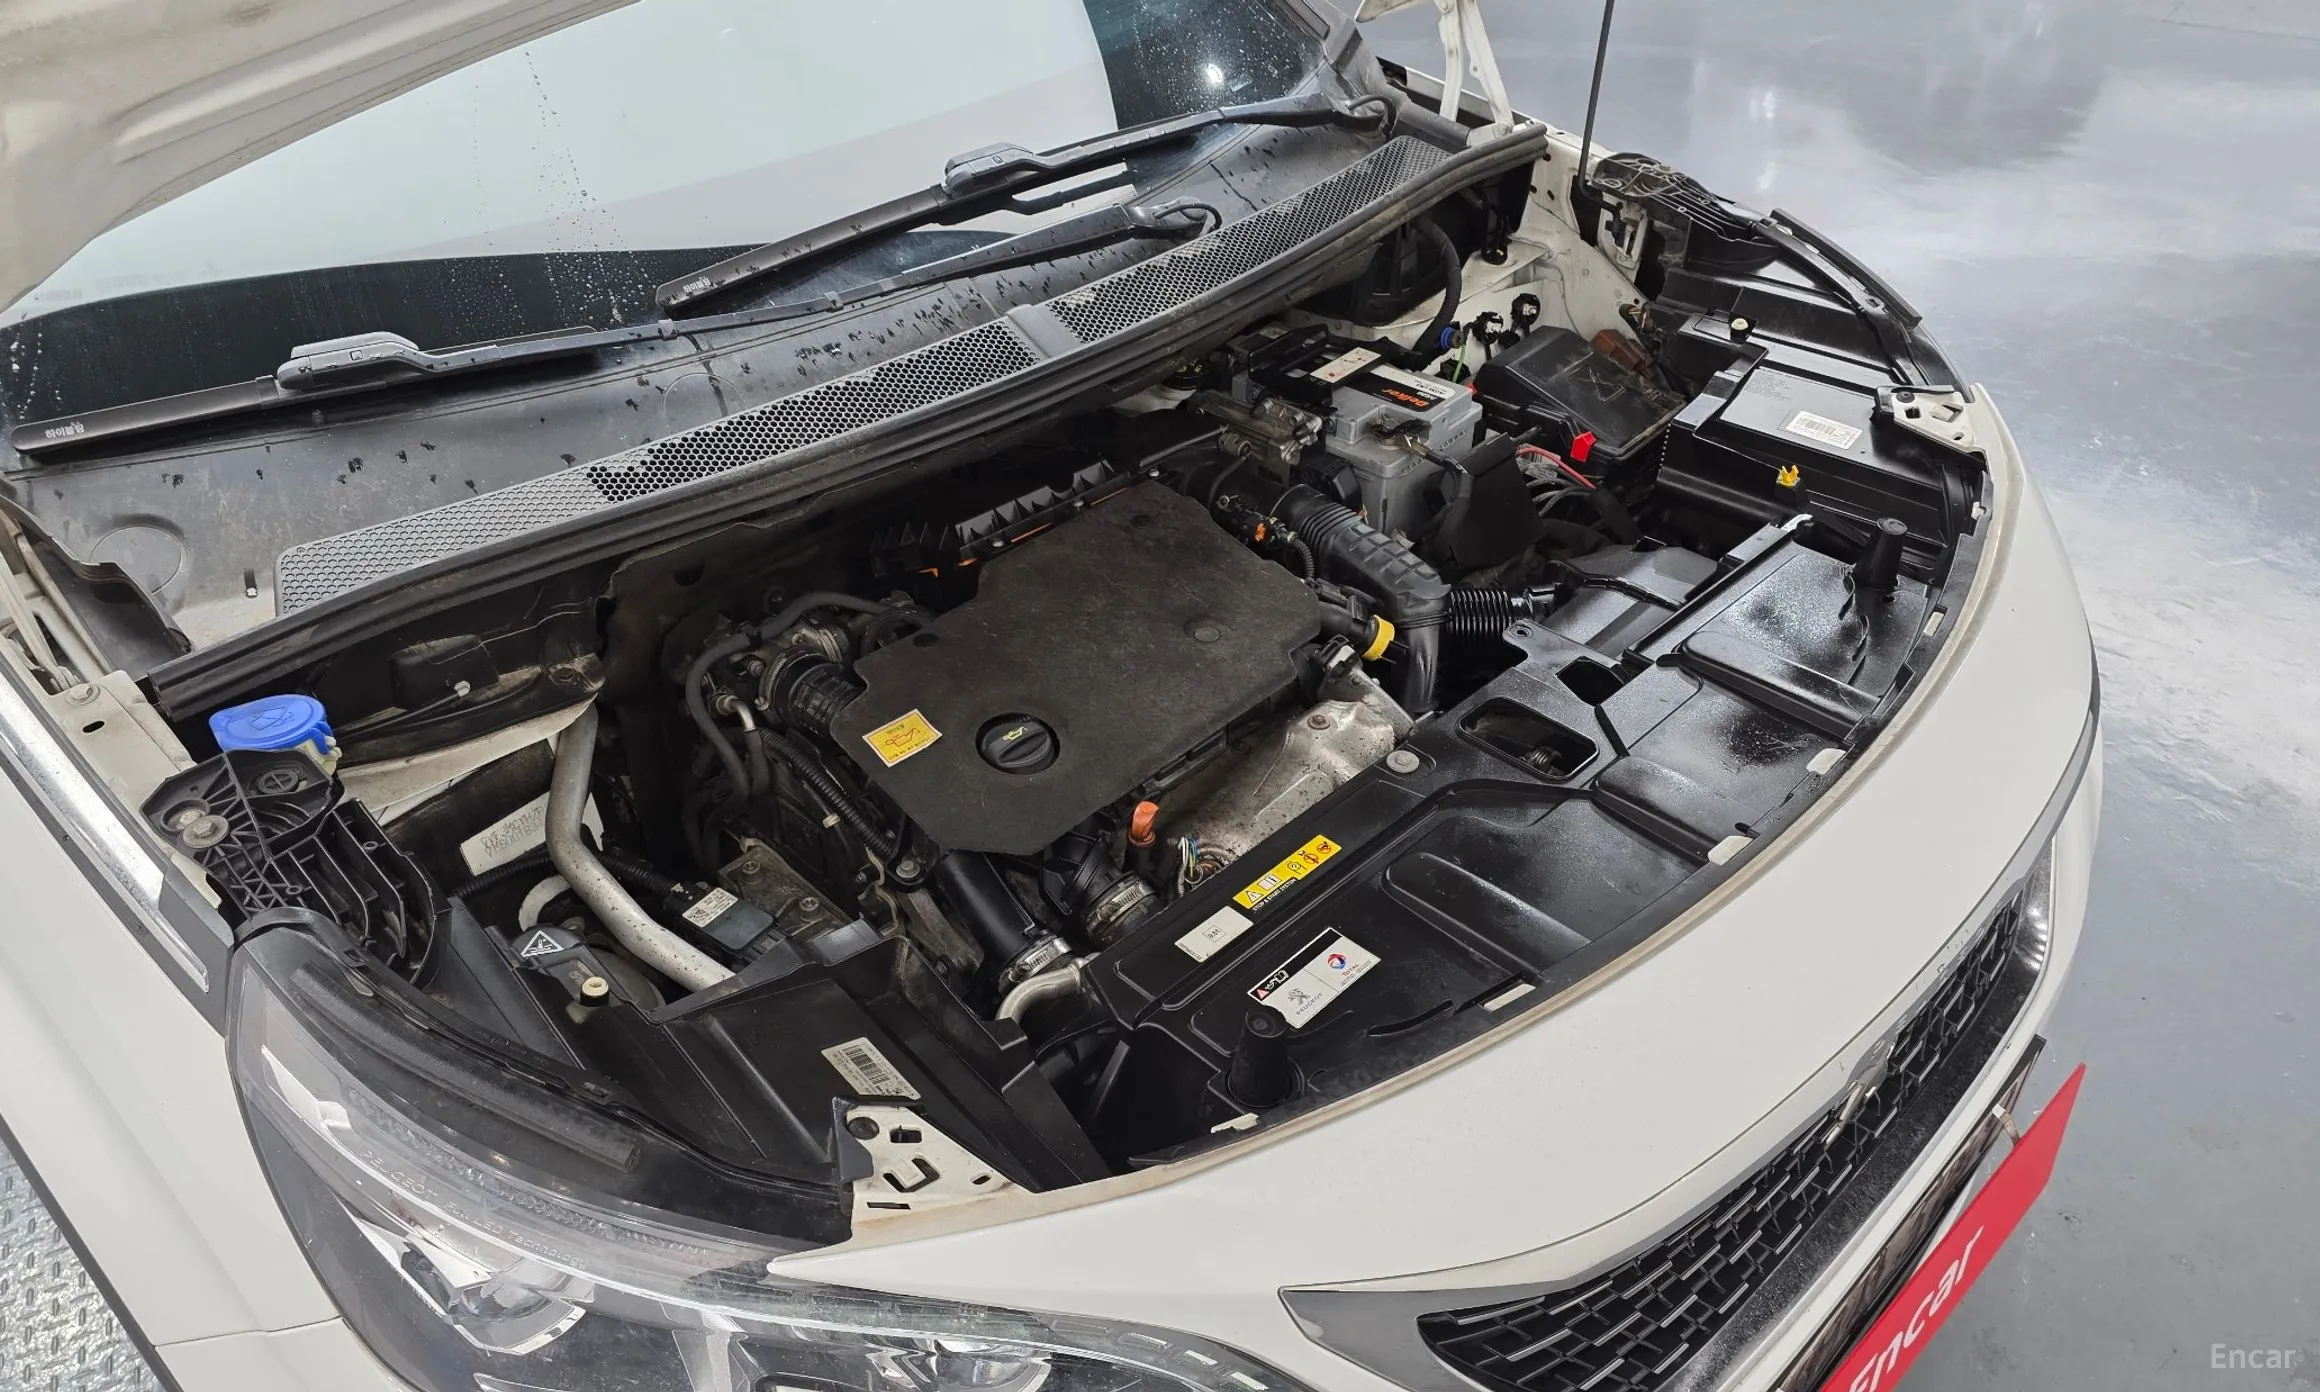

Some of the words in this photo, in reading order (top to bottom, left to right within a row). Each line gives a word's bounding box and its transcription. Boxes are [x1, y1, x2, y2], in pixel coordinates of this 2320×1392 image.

[1341, 963, 1359, 977] TOTAL
[1296, 992, 1323, 1016] PEUGEOT
[473, 1219, 502, 1235] LED
[507, 1230, 588, 1270] Technology
[1849, 1225, 1984, 1392] Encar
